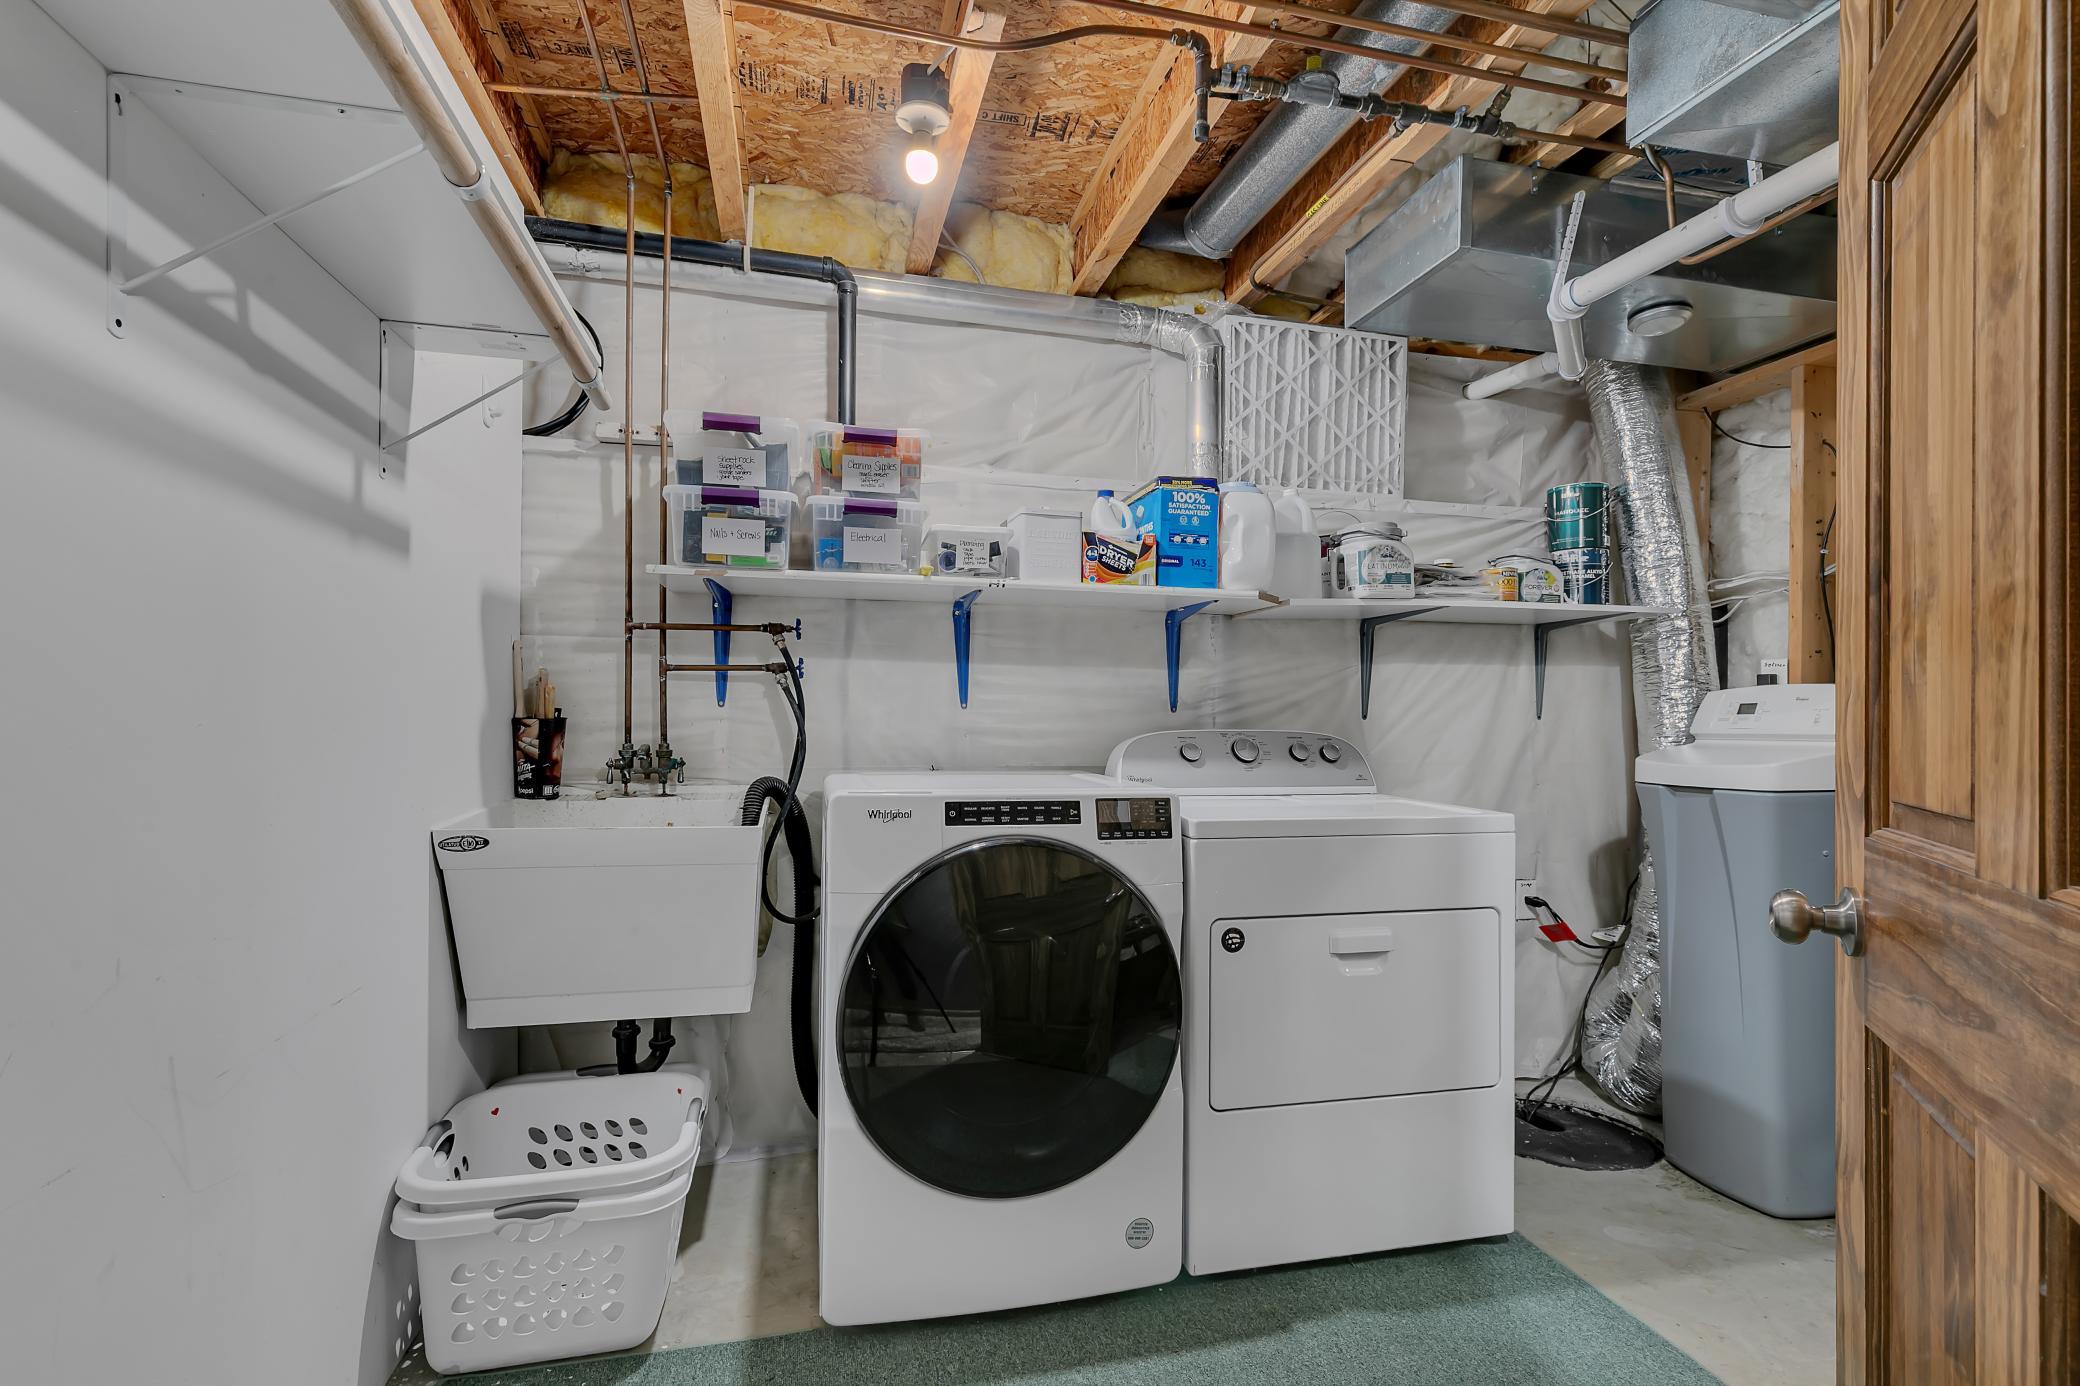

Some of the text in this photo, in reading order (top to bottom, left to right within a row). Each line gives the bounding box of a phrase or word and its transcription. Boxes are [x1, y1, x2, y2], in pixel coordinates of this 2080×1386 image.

[992, 111, 1020, 123] SHIFT
[1172, 491, 1206, 504] 100%
[1168, 502, 1211, 510] SATISFACTION
[710, 527, 728, 539] Nails
[736, 528, 761, 540] Screws
[850, 531, 886, 543] Electrical
[1099, 545, 1135, 569] DRYER
[1101, 555, 1127, 571] SHEETS
[1190, 558, 1207, 568] 143
[867, 809, 912, 823] Whirlpool
